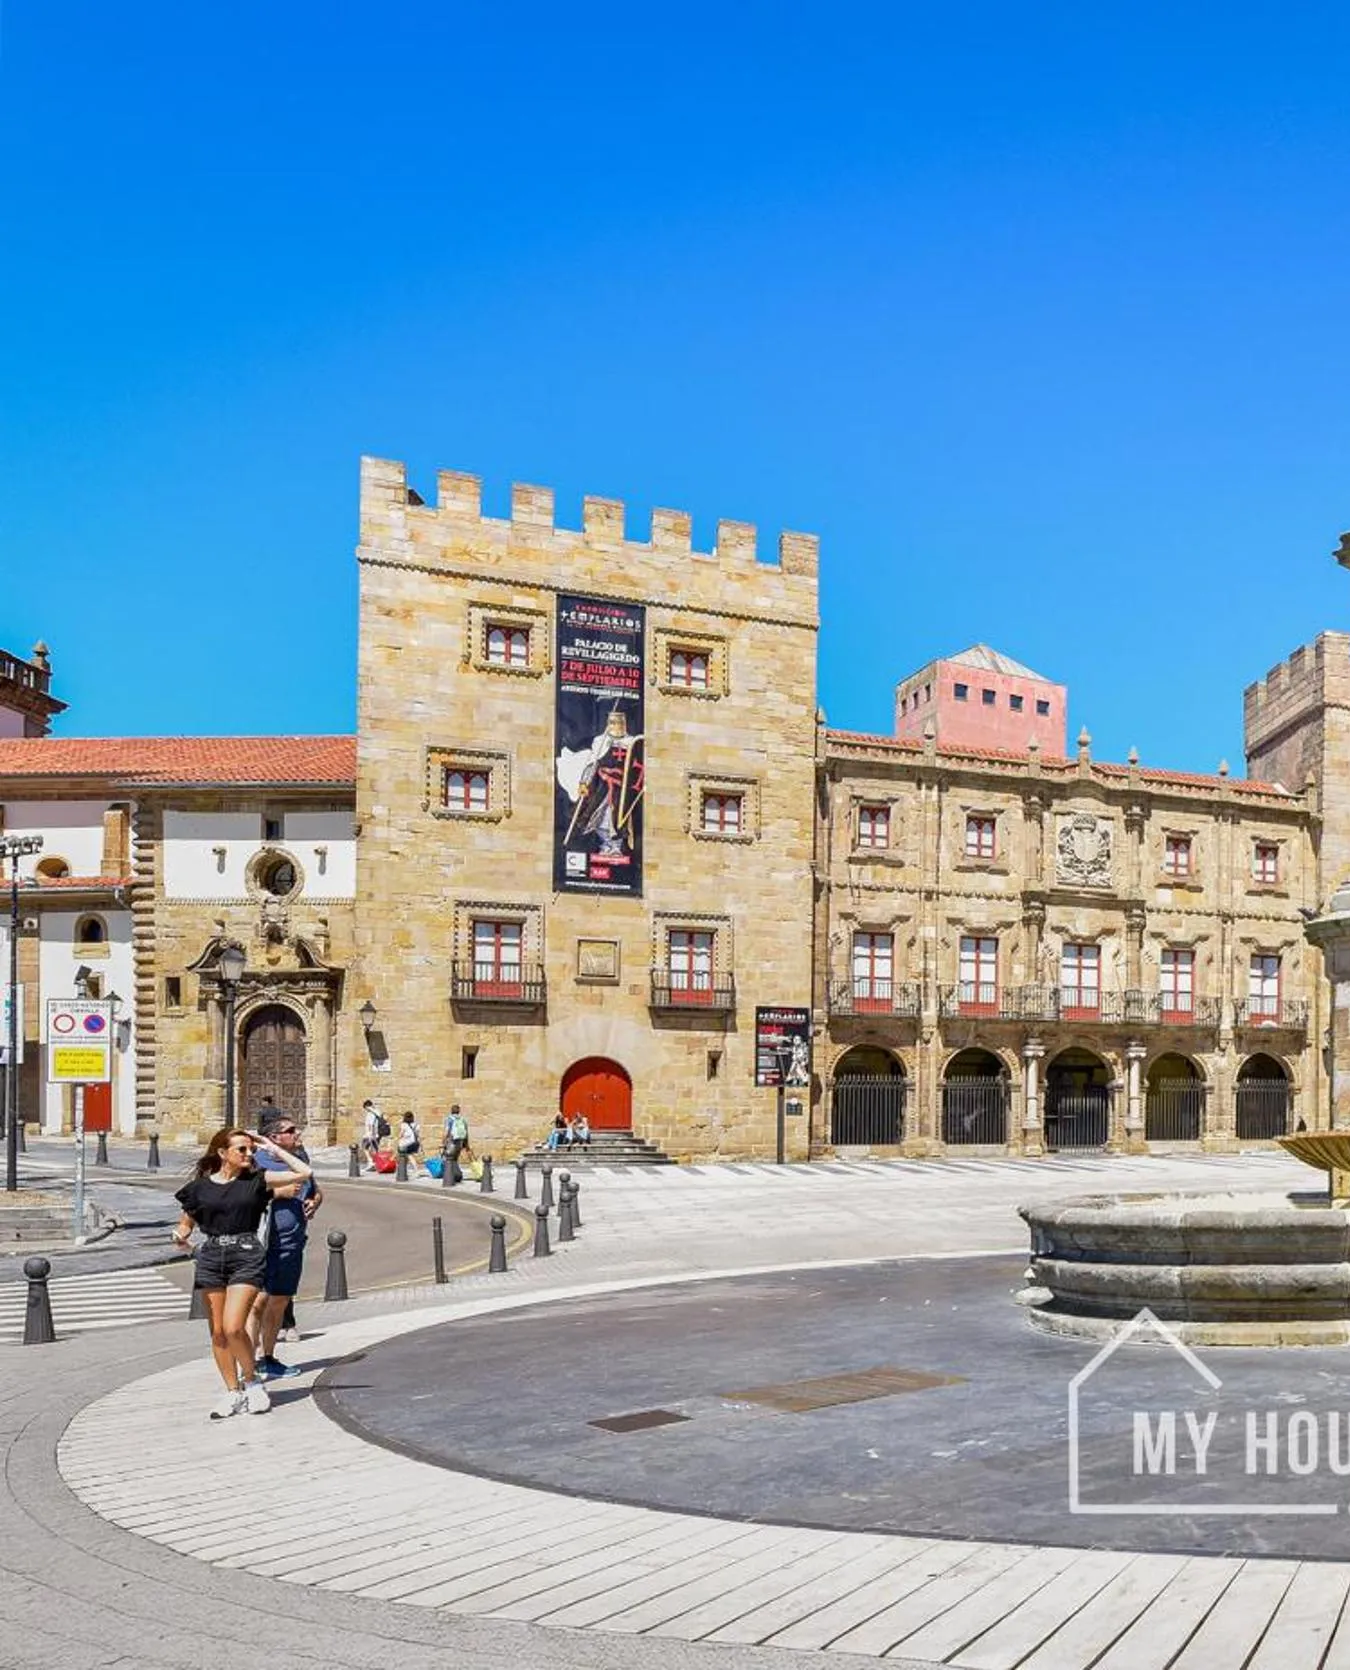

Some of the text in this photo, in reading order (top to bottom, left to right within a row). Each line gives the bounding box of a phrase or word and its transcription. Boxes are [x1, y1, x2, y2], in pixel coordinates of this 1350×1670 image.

[574, 638, 628, 652] PALACIO DE
[561, 645, 640, 664] REVILLAGIGEDO
[569, 661, 585, 671] DE
[585, 664, 617, 675] JULIO
[618, 668, 626, 677] A
[561, 671, 639, 688] DE SEPTIEMBRE
